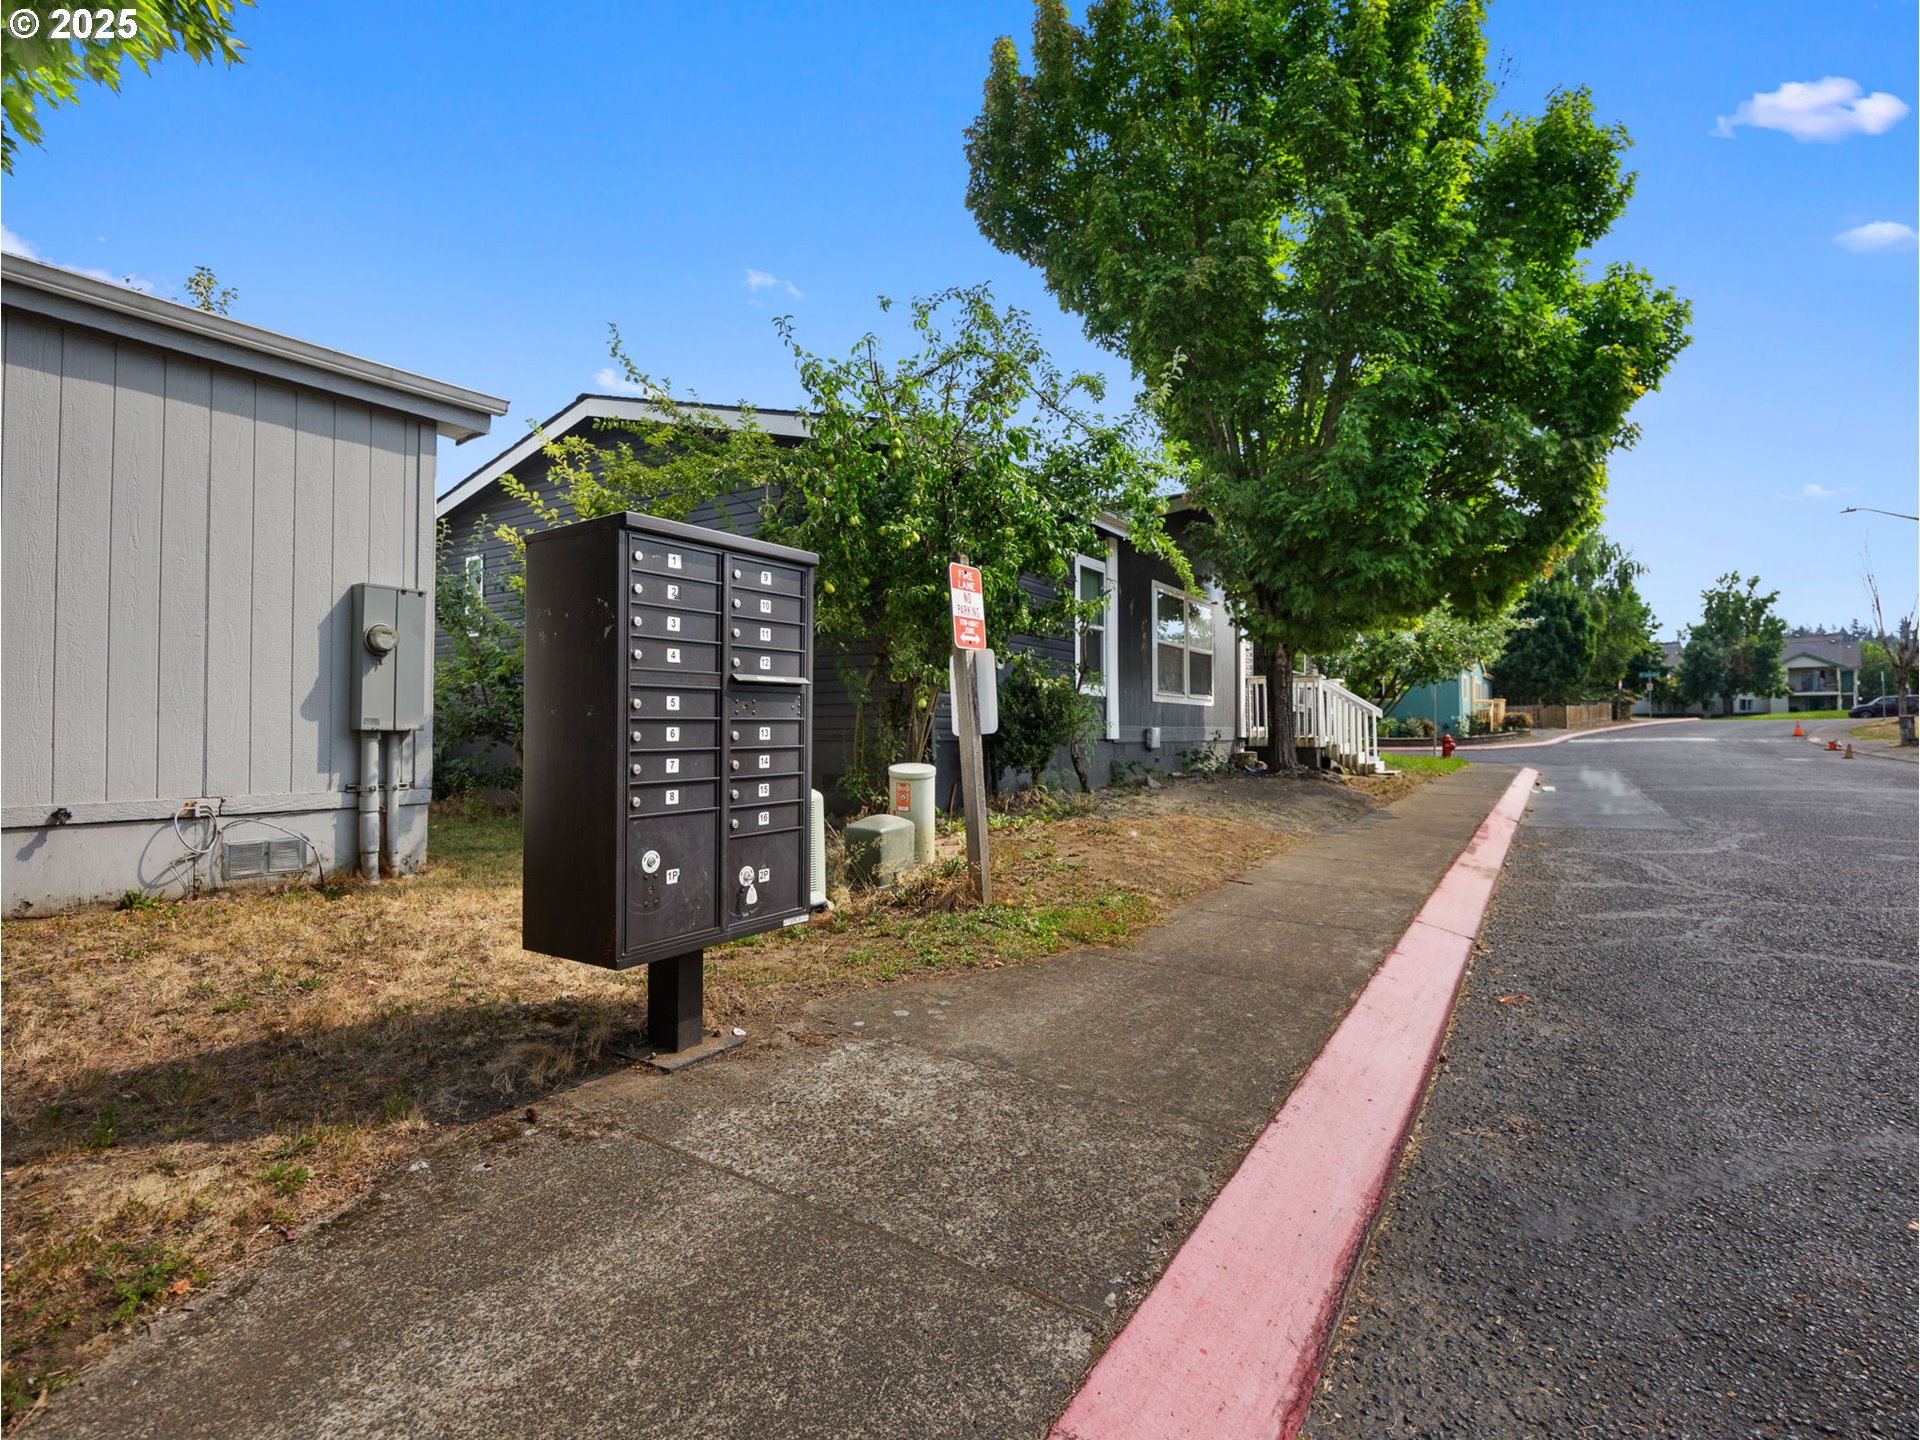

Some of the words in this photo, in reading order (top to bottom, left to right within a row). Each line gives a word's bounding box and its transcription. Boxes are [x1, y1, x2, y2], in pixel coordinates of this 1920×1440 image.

[957, 580, 976, 591] LANE
[670, 588, 677, 597] 2
[963, 592, 972, 604] NO
[761, 602, 770, 611] 10
[670, 619, 677, 628] 3
[761, 630, 770, 639] 11
[670, 651, 676, 660] 4
[761, 658, 770, 667] 12
[669, 698, 676, 707] 5
[669, 729, 676, 739] 6
[760, 729, 770, 738] 13
[669, 760, 676, 770] 7
[760, 757, 769, 766] 14
[760, 785, 769, 794] 15
[669, 791, 675, 801] 8
[759, 813, 769, 822] 16
[667, 870, 679, 881] 1P
[759, 870, 769, 880] 2P
